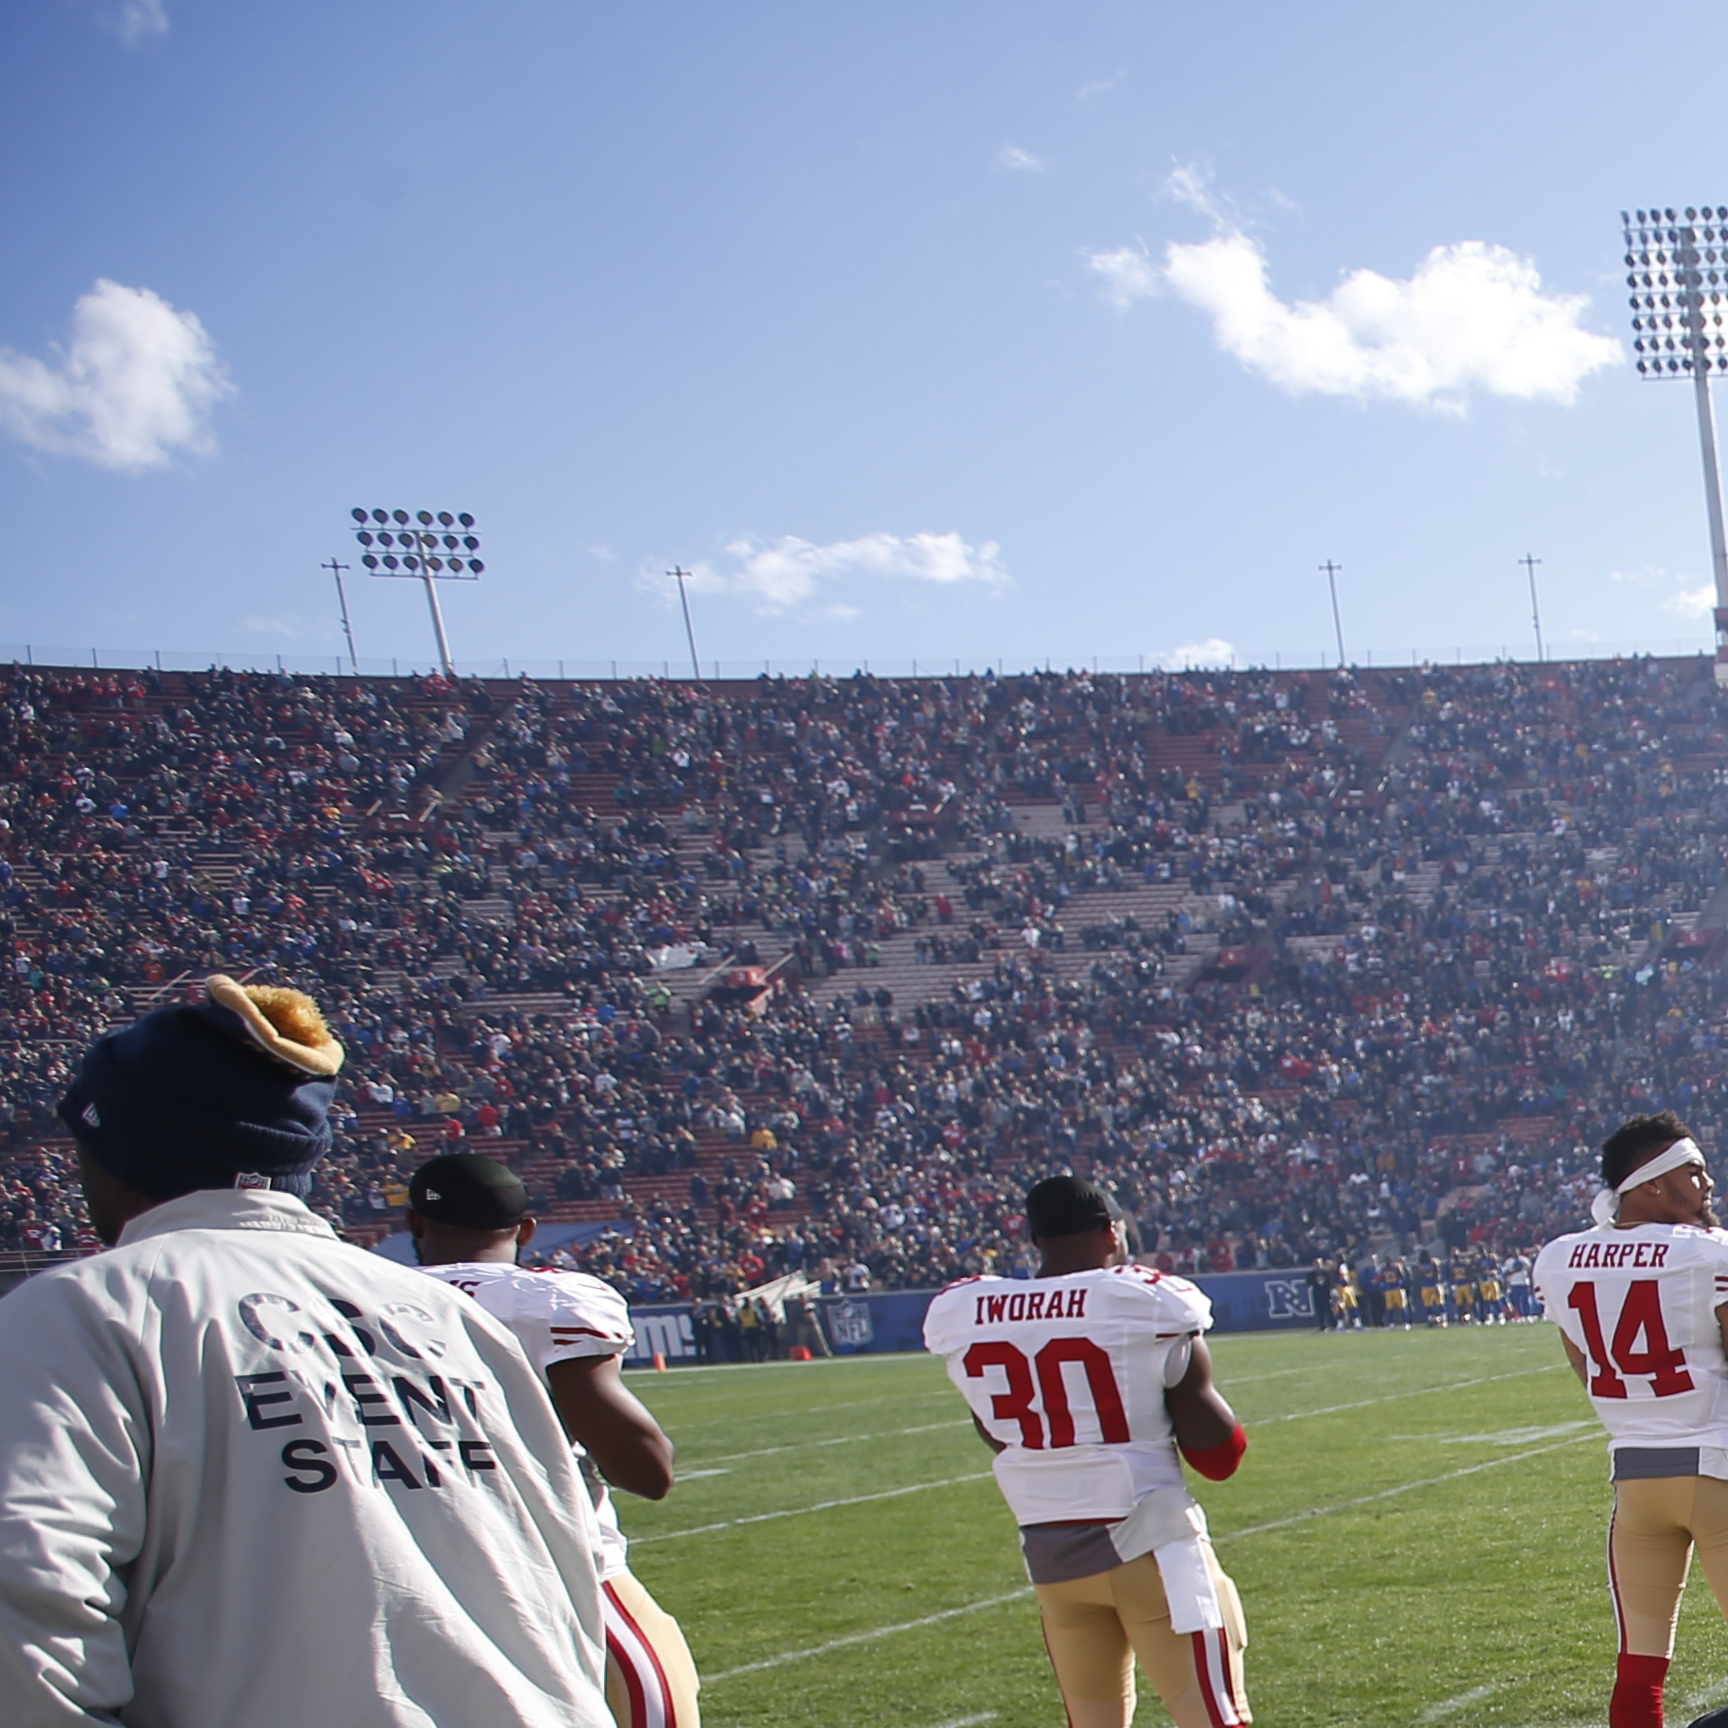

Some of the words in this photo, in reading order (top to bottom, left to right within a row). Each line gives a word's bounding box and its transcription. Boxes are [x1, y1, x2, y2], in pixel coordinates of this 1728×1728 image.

[1567, 1242, 1670, 1268] HARPER
[238, 1292, 447, 1361] CSC
[974, 1289, 1087, 1326] IWORAH
[1567, 1279, 1695, 1399] 14
[234, 1370, 486, 1431] EVENT
[963, 1336, 1131, 1450] 30
[281, 1438, 496, 1494] STAFF
